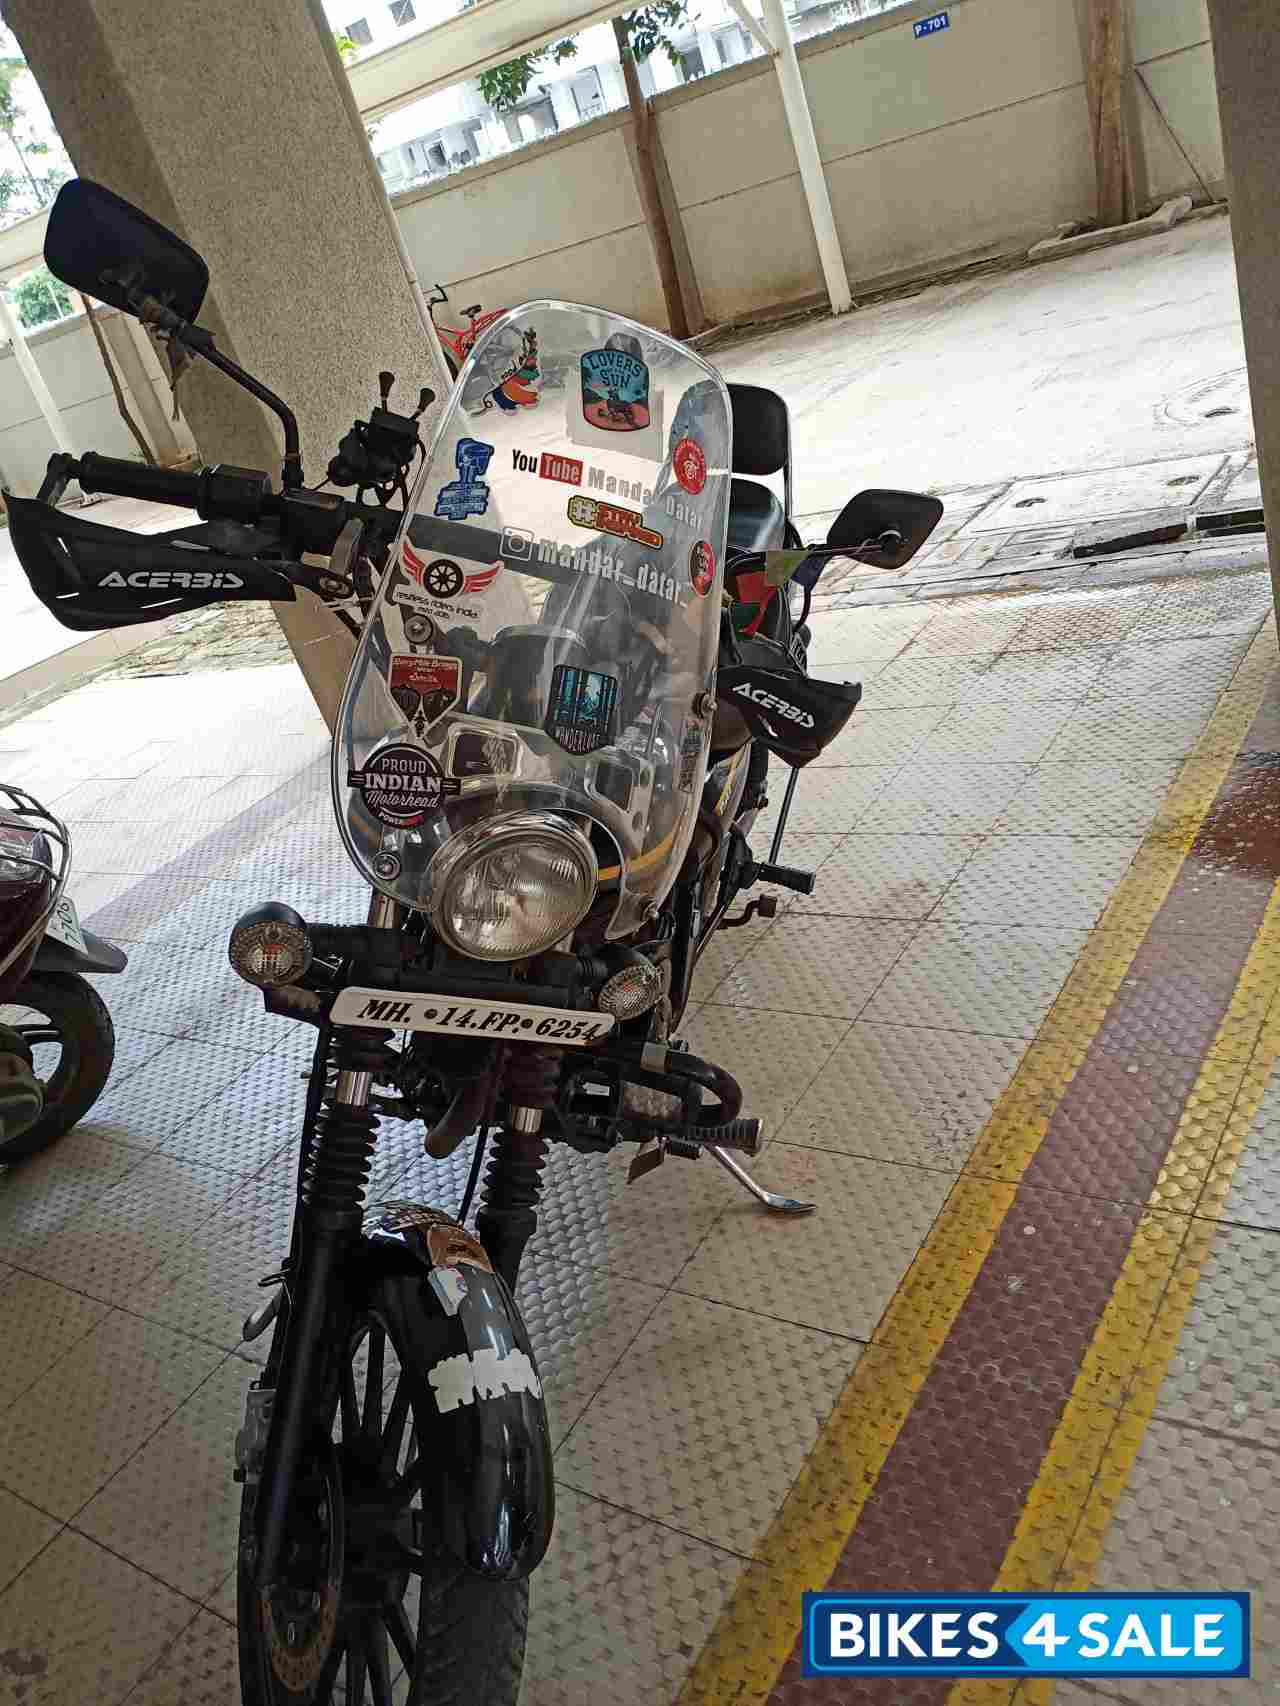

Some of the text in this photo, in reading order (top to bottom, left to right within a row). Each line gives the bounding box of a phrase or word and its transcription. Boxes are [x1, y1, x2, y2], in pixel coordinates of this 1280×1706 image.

[382, 758, 426, 774] PROUD
[364, 773, 442, 793] INDIAN
[534, 1017, 603, 1041] 6254
